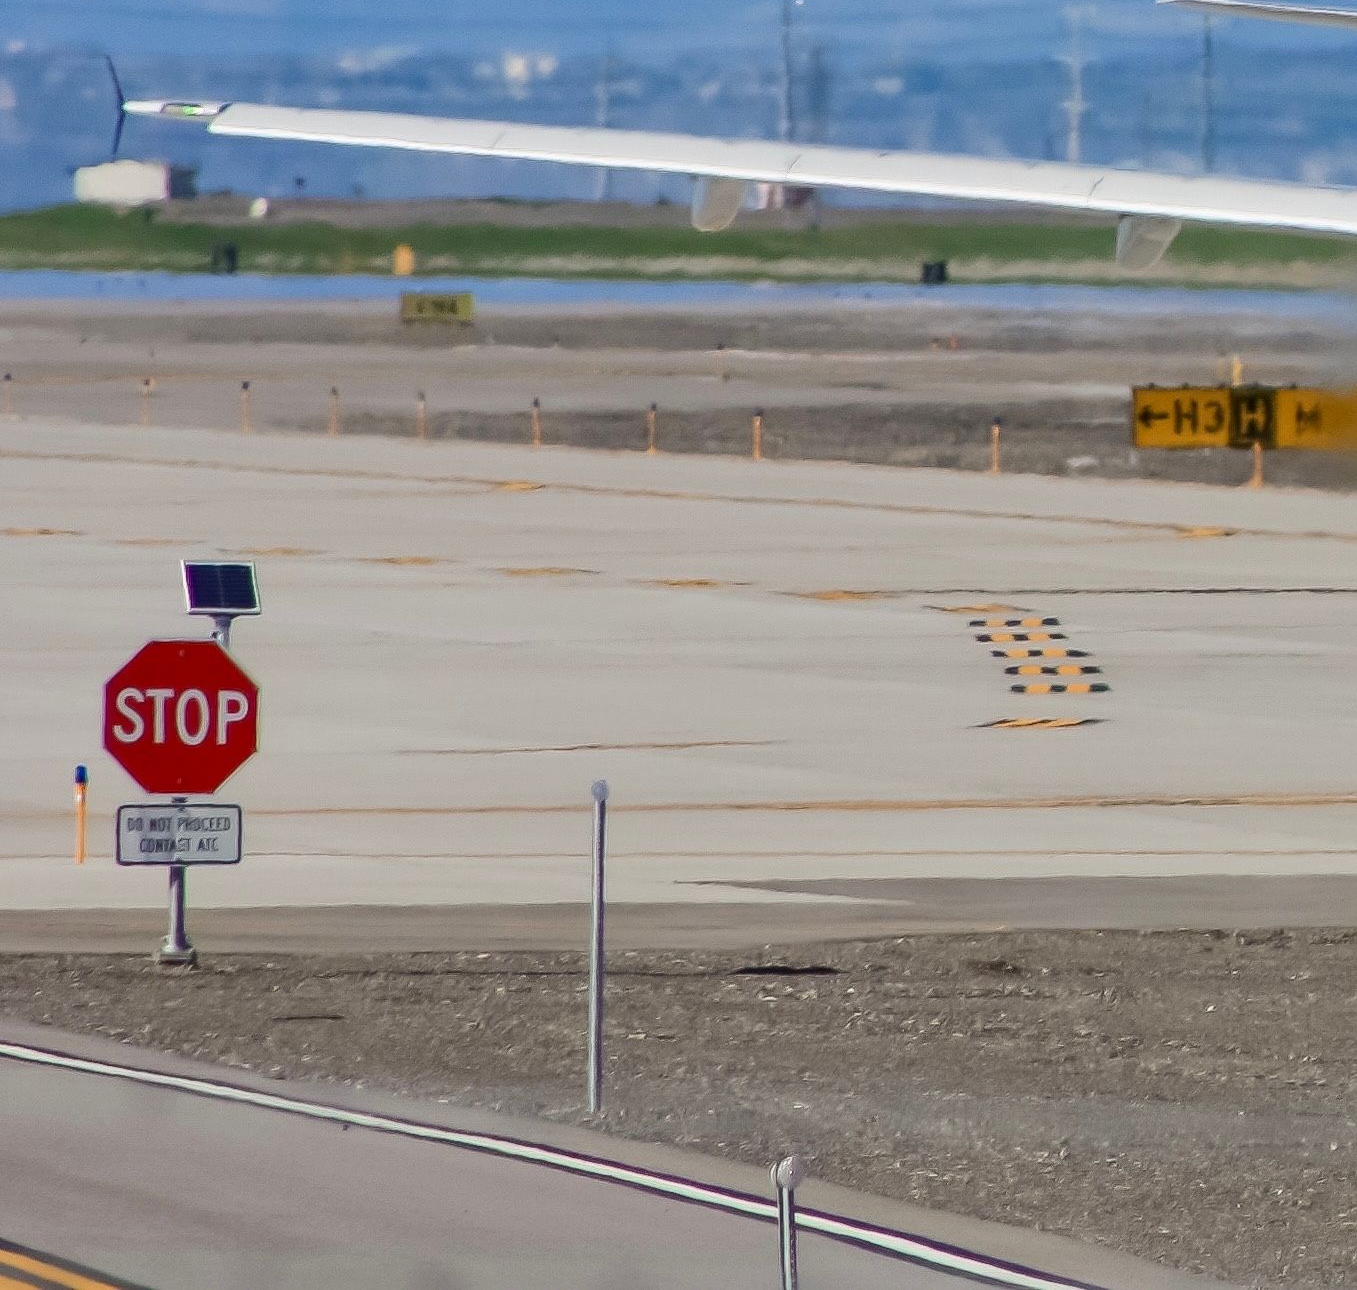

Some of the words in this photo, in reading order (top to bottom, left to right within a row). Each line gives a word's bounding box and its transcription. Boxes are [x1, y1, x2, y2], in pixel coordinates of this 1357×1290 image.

[1173, 398, 1225, 434] H3
[112, 687, 249, 746] STOP
[127, 817, 143, 832] DO
[149, 817, 172, 832] NOT
[177, 817, 231, 832] PROCEED
[140, 838, 192, 853] CONTACT
[197, 838, 219, 852] ATC
